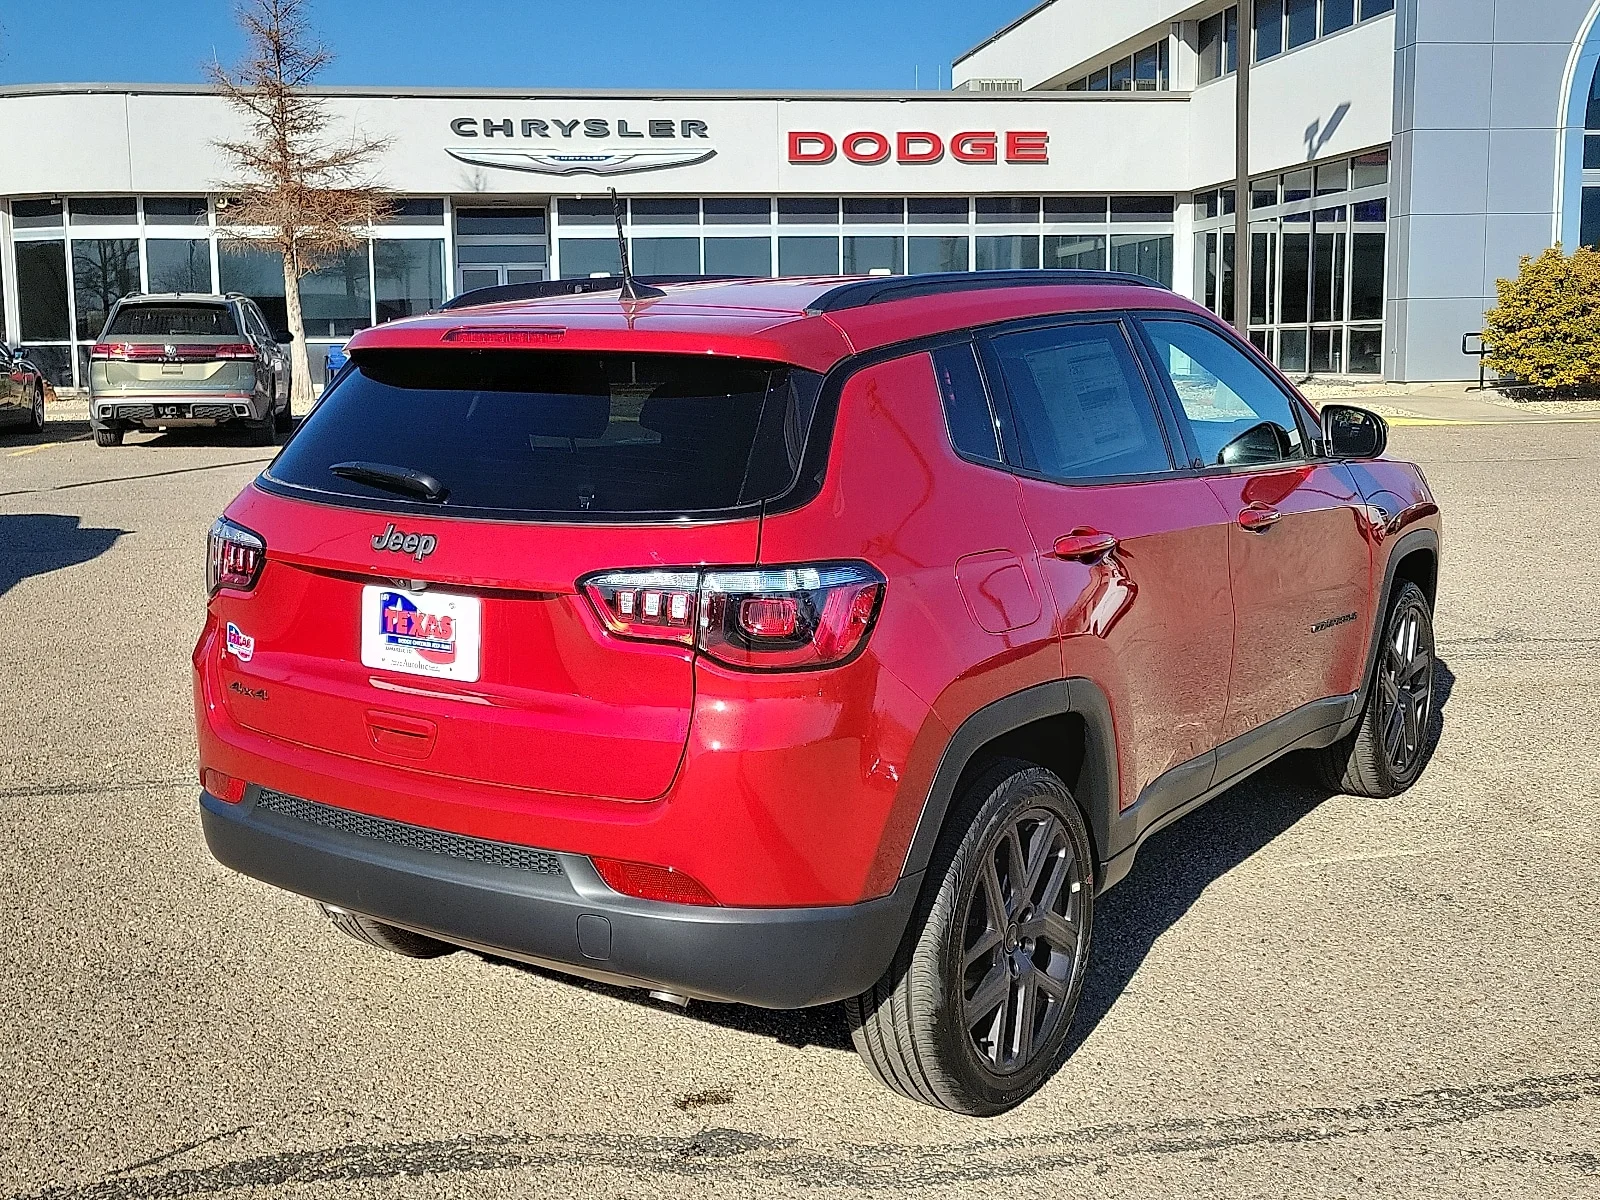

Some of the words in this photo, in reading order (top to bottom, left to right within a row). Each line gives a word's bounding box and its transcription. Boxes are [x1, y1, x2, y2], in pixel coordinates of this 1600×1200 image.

[449, 117, 710, 139] CHRYSLER
[787, 131, 1049, 165] DODGE
[371, 523, 437, 561] Jeep
[384, 608, 453, 640] TEXAS
